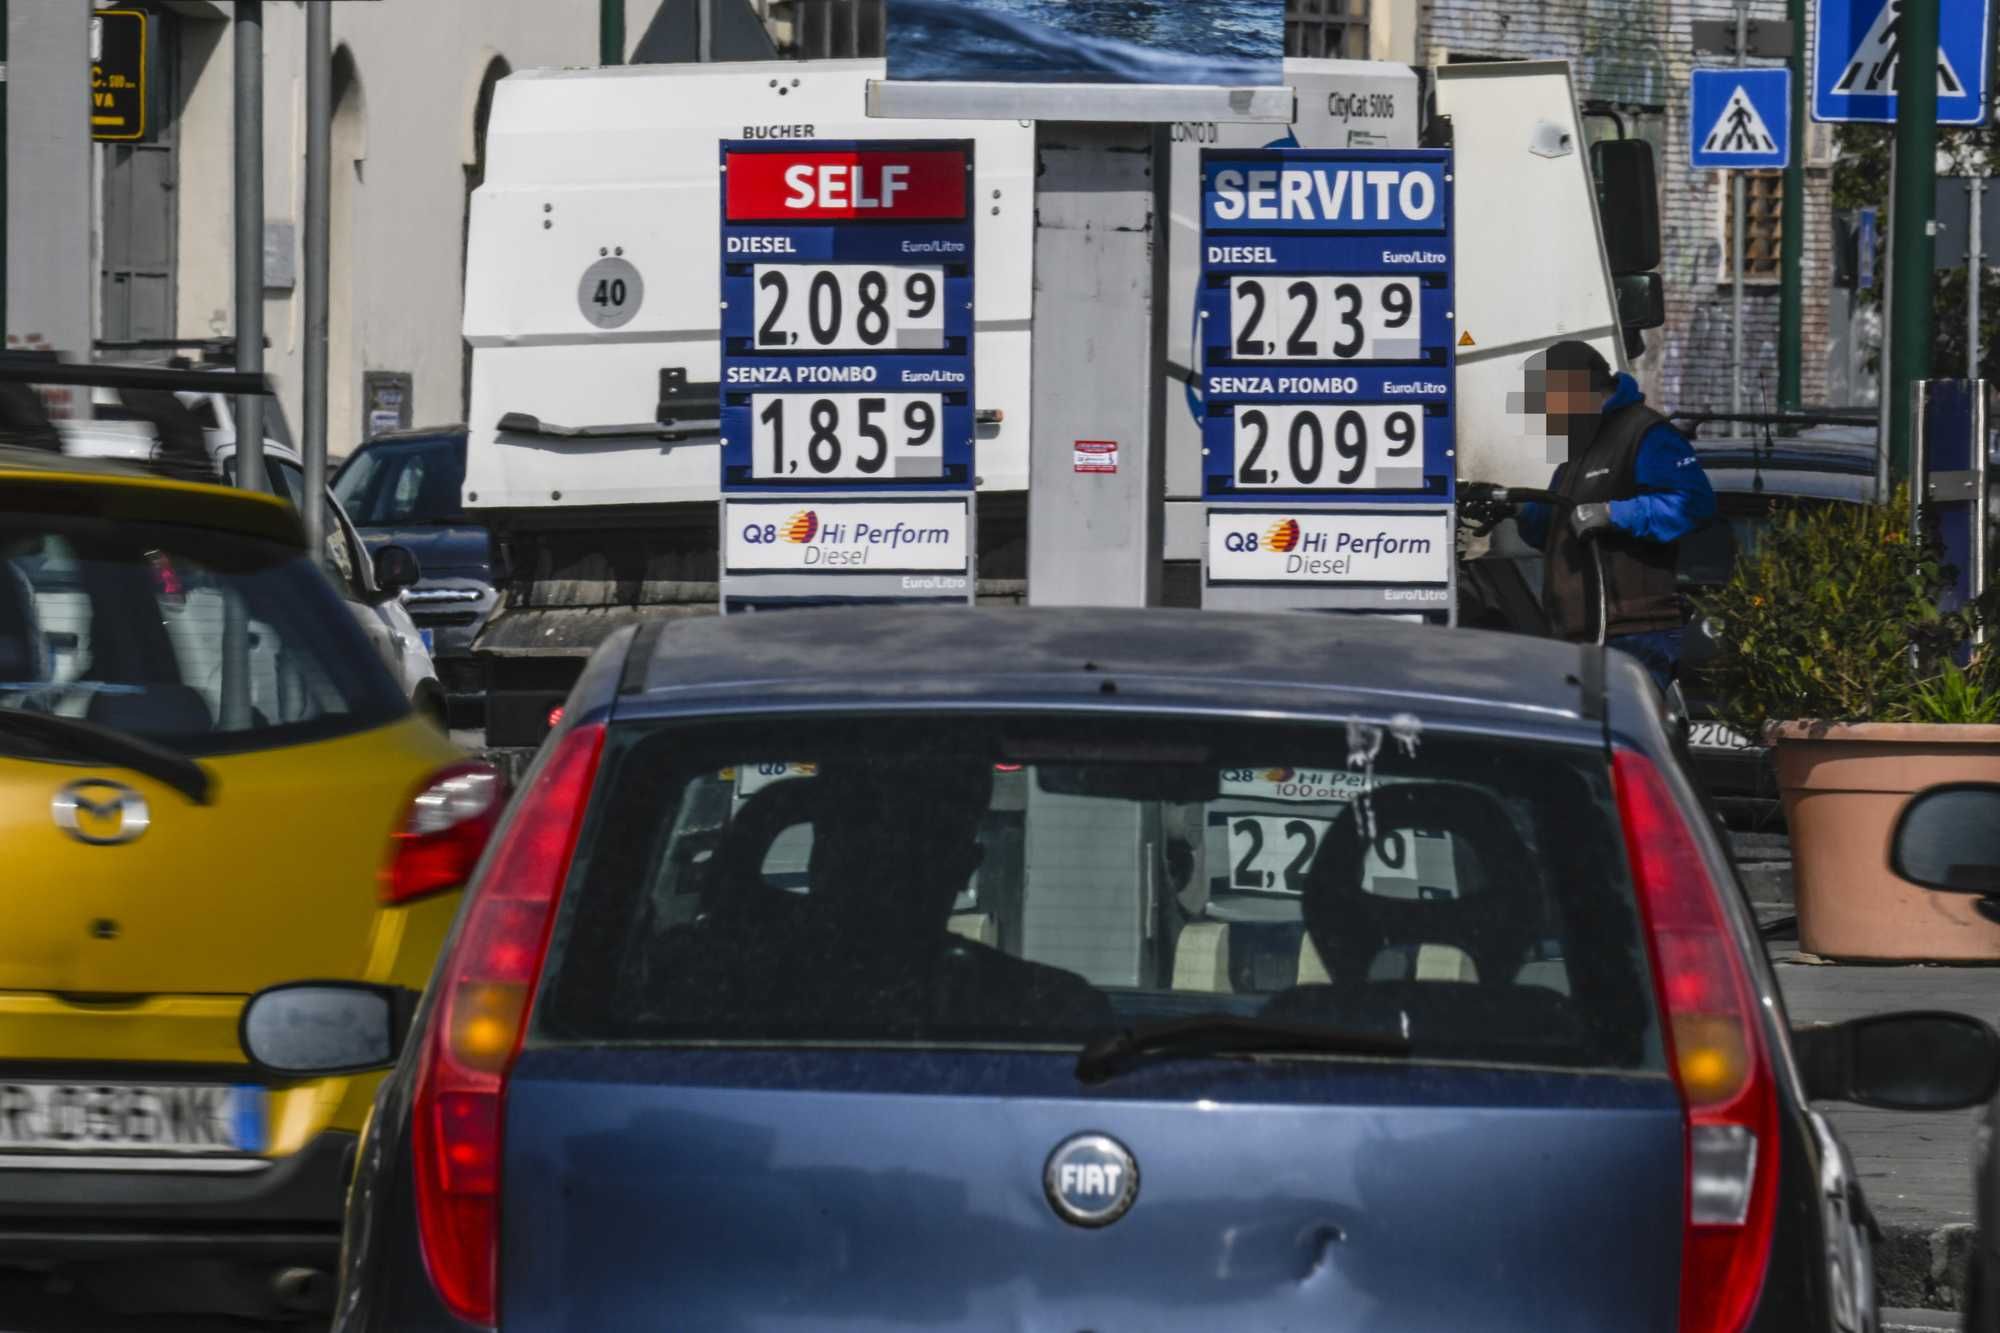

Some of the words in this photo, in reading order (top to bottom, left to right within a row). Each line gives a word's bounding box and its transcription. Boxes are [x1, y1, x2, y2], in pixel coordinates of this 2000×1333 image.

[1328, 92, 1368, 123] CityCat
[1370, 94, 1393, 118] 5006
[743, 124, 815, 139] BUCHER
[784, 164, 909, 209] SELF
[1214, 169, 1434, 221] SERVITO
[727, 237, 796, 253] DIESEL
[902, 241, 965, 252] Euro/Litro
[1208, 247, 1277, 264] DIESEL
[1383, 251, 1446, 264] Euro/Litro
[593, 279, 626, 307] 40
[727, 367, 792, 383] SENZA
[797, 367, 877, 382] PIOMBO
[902, 371, 965, 383] Euro/Litro
[1209, 377, 1275, 393] SENZA
[1279, 378, 1358, 393] PIOMBO
[1383, 382, 1446, 394] Euro/Litro
[743, 524, 776, 545] Q8
[821, 524, 847, 544] Hi
[854, 522, 949, 549] Perform
[1225, 532, 1259, 553] Q8
[1303, 532, 1328, 553] Hi
[1336, 532, 1431, 559] Perform
[804, 546, 869, 566] Diesel
[1286, 554, 1351, 575] Diesel
[902, 577, 966, 590] Euro/Litro
[1384, 589, 1448, 601] Euro/Litro
[1222, 768, 1254, 783] Q8
[1298, 773, 1325, 784] Hi
[1276, 784, 1310, 797] 100
[1061, 1164, 1121, 1195] FIAT
